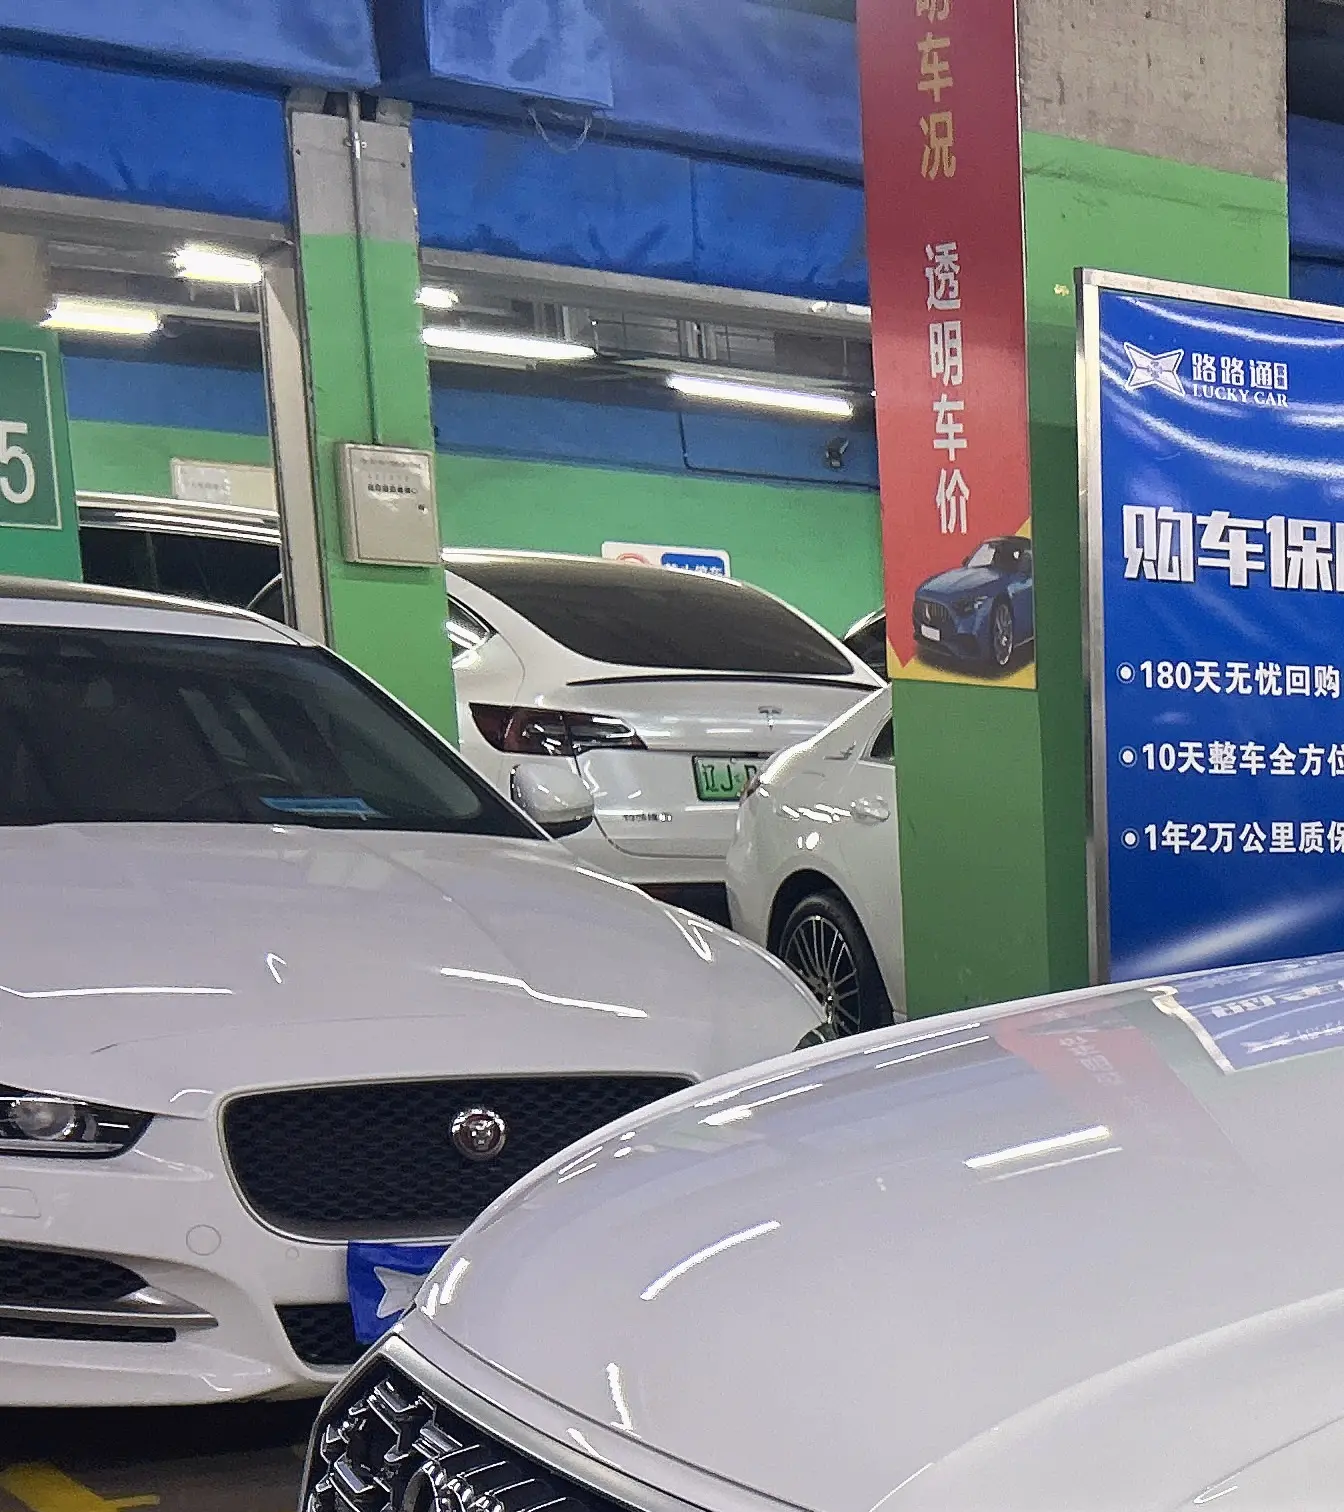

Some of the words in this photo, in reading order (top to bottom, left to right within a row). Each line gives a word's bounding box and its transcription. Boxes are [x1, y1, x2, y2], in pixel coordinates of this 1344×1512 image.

[923, 241, 971, 536] 透明车价
[1191, 352, 1273, 390] 路路通
[1192, 383, 1248, 403] LUCKY
[1253, 389, 1289, 408] CAR
[1138, 660, 1341, 699] 180天无忧回购
